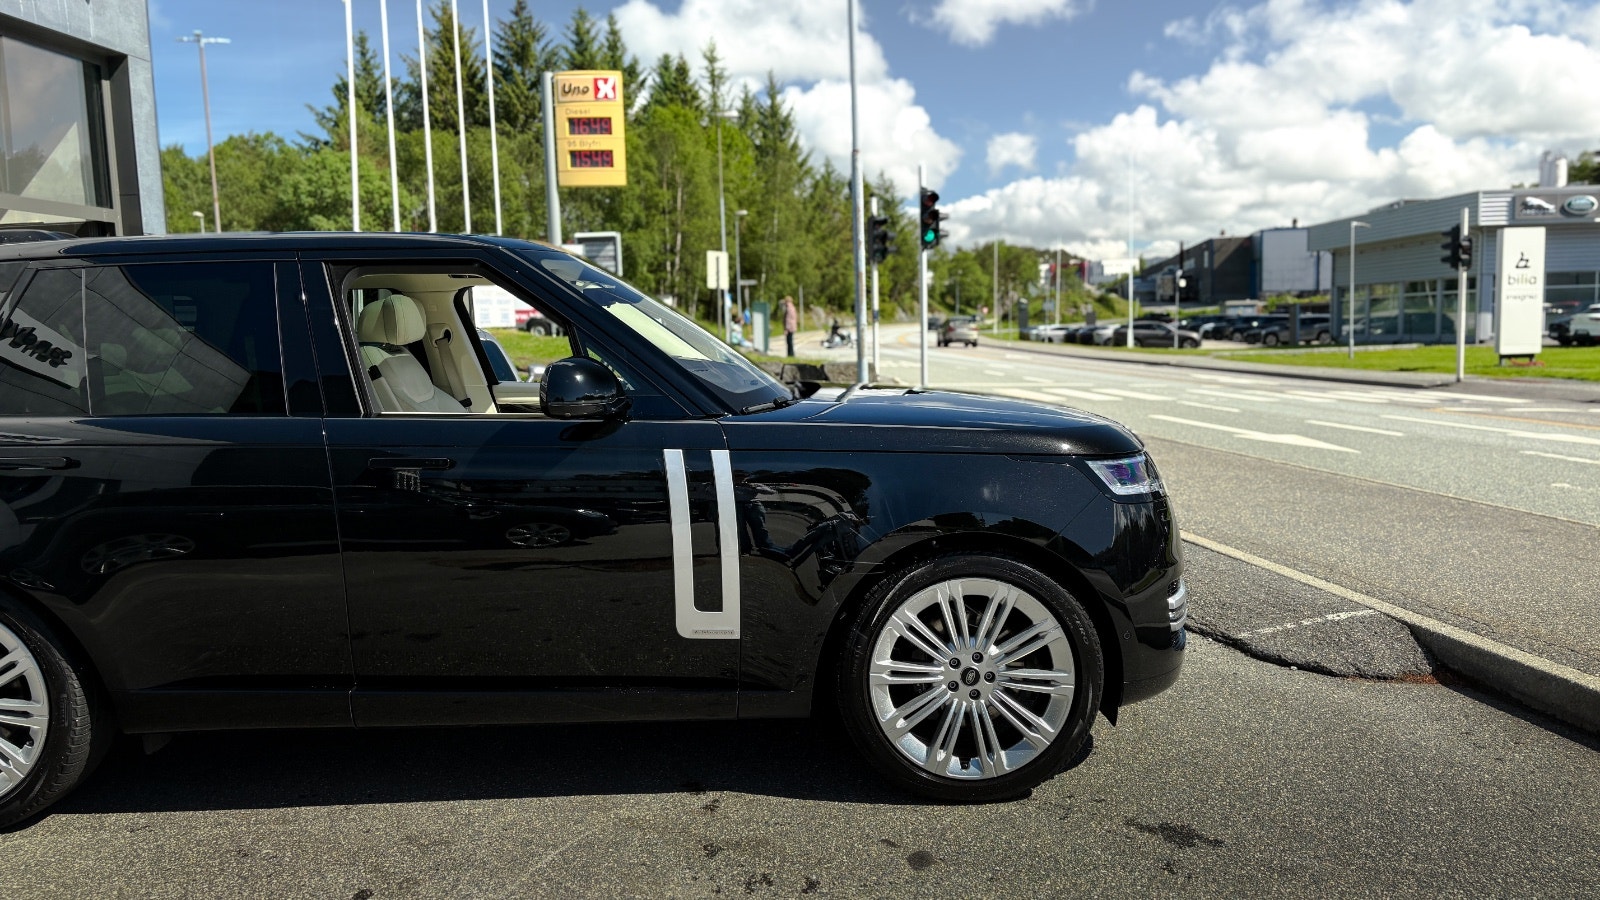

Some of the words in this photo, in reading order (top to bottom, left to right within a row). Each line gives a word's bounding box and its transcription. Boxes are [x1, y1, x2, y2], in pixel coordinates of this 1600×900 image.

[561, 82, 590, 97] Uno
[595, 77, 616, 99] X
[565, 108, 590, 116] Diesel
[573, 117, 611, 135] 1649
[575, 150, 612, 167] 1549
[1507, 274, 1538, 286] bilia
